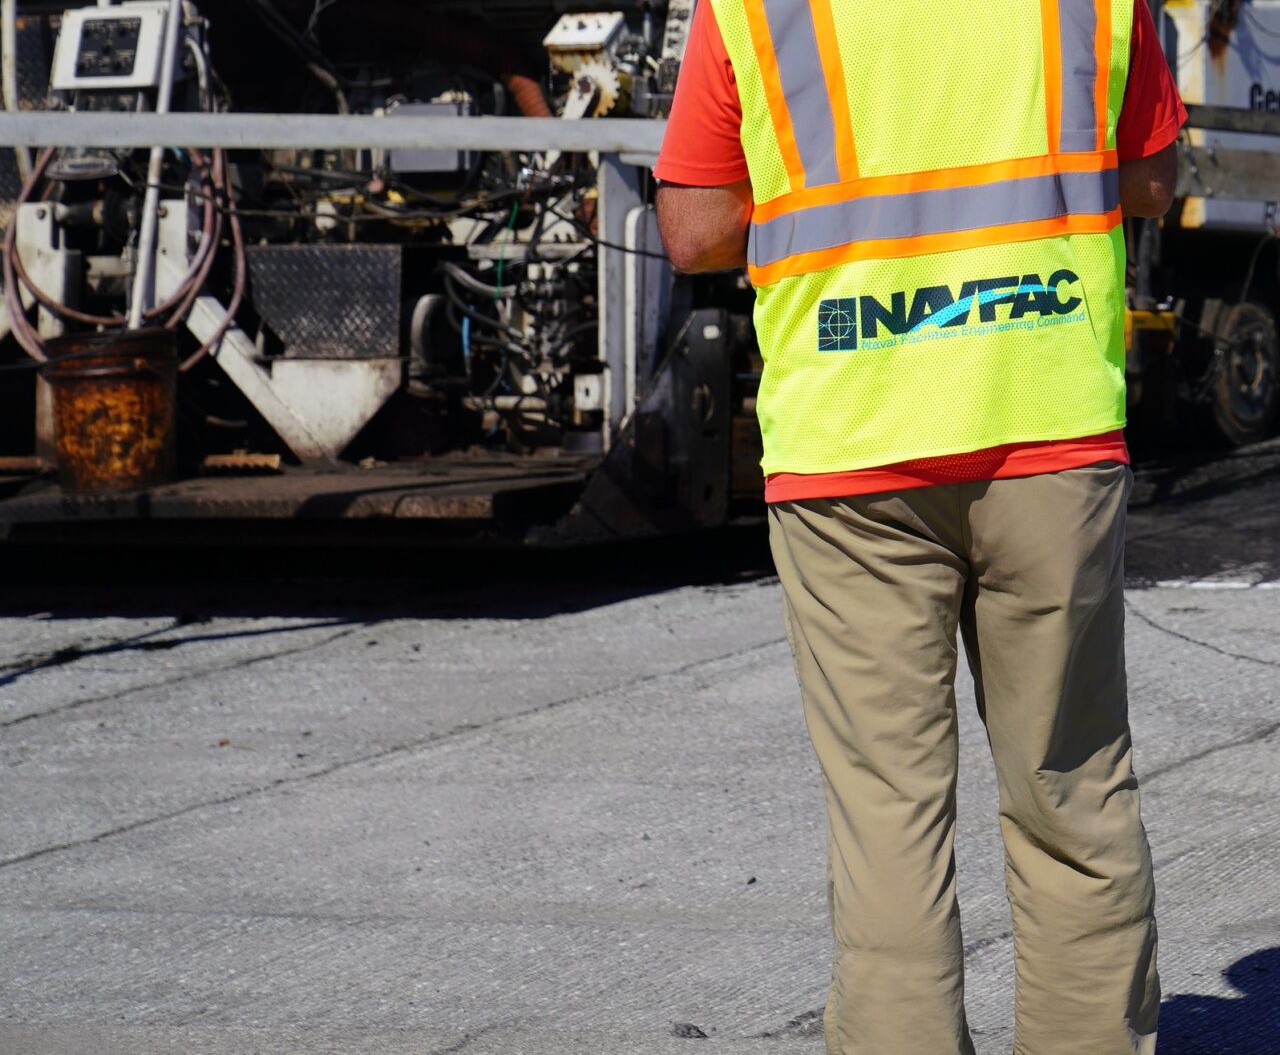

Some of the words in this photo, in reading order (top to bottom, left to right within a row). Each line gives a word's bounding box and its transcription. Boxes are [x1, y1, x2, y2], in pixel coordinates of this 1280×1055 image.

[859, 269, 1082, 338] NAVFAC
[861, 336, 896, 350] Naval
[900, 329, 958, 345] Facilities
[961, 318, 1034, 337] Engineering
[1037, 311, 1086, 328] Command
